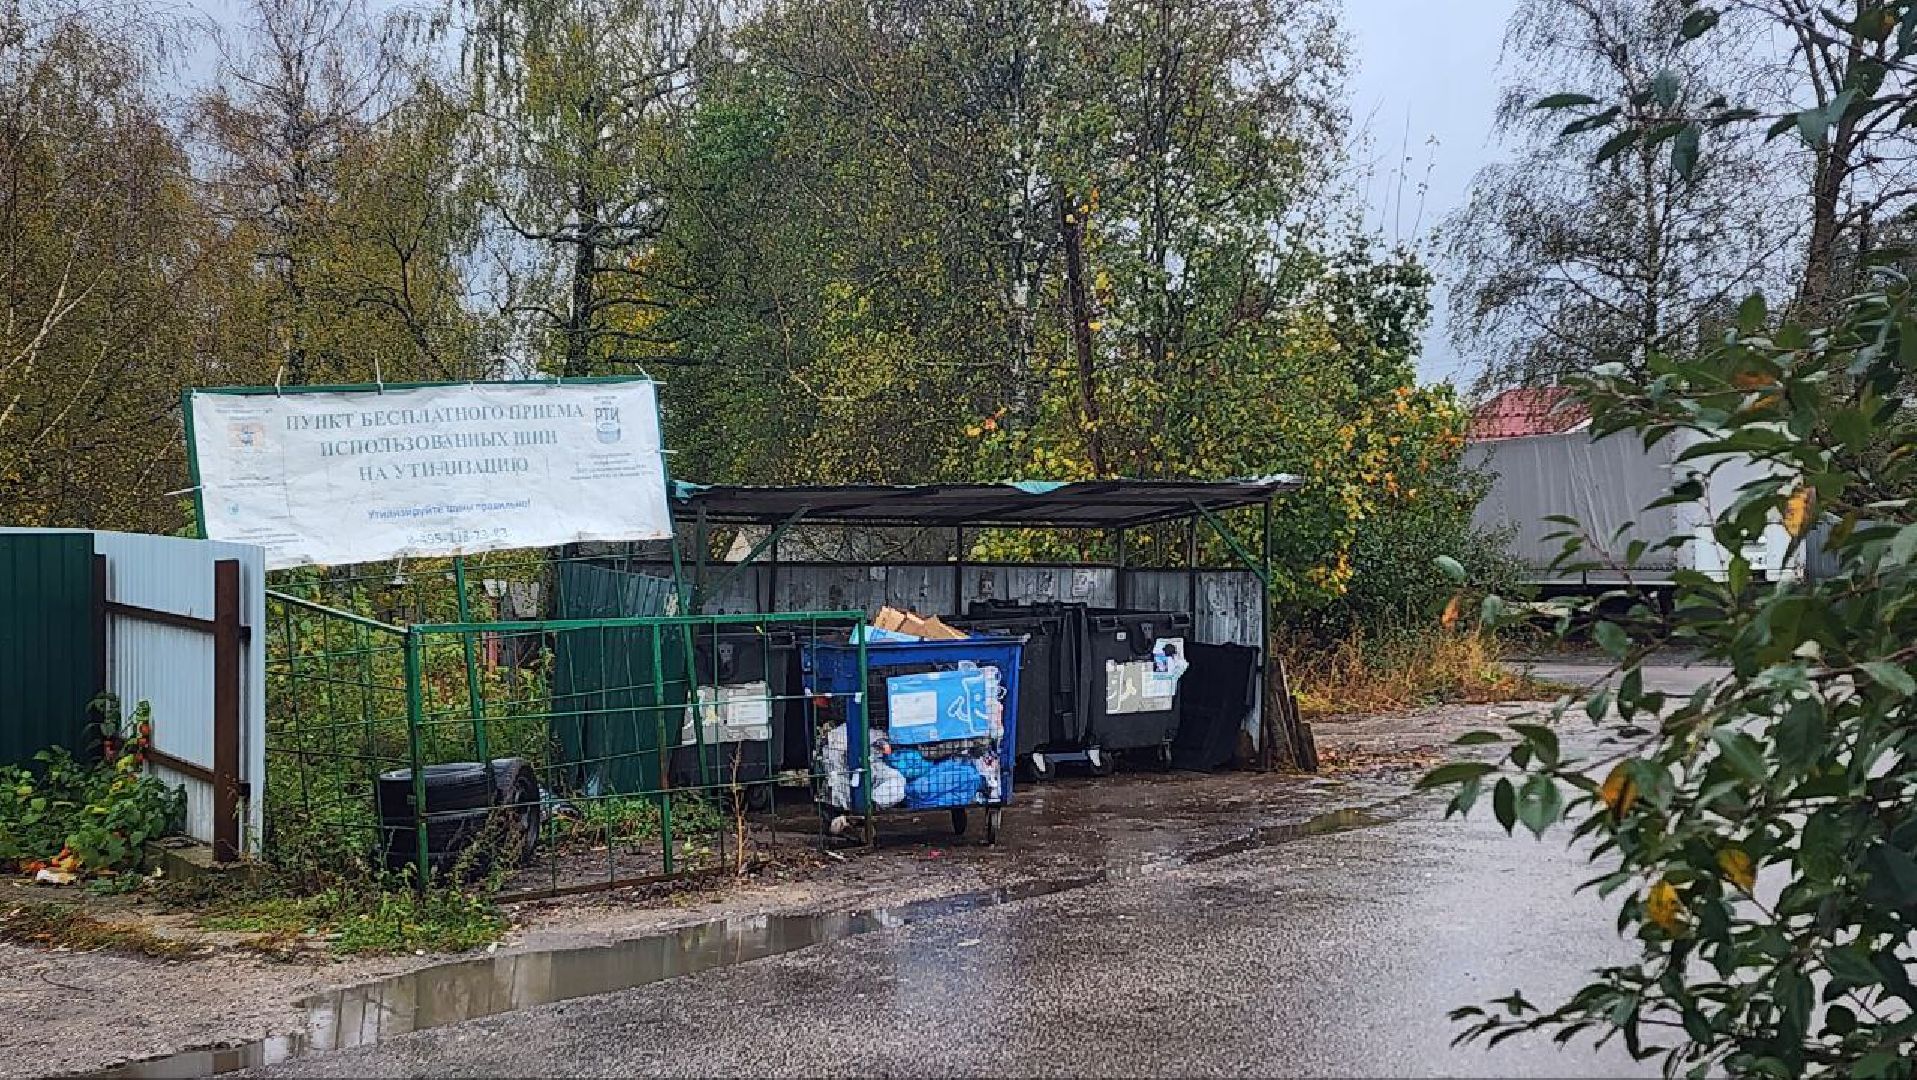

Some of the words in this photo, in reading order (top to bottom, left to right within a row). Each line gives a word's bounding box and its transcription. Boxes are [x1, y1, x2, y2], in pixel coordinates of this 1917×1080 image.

[286, 413, 354, 430] ПУНКТ
[361, 406, 504, 427] БЕСПЛАТНОГО
[509, 403, 584, 419] ПРИЕМА
[320, 432, 509, 457] ИСПОЛЬЗОВАННЫХ
[514, 430, 558, 445] ШИН
[358, 466, 388, 481] НА
[394, 457, 529, 479] УТИЛИЗАЦИЮ
